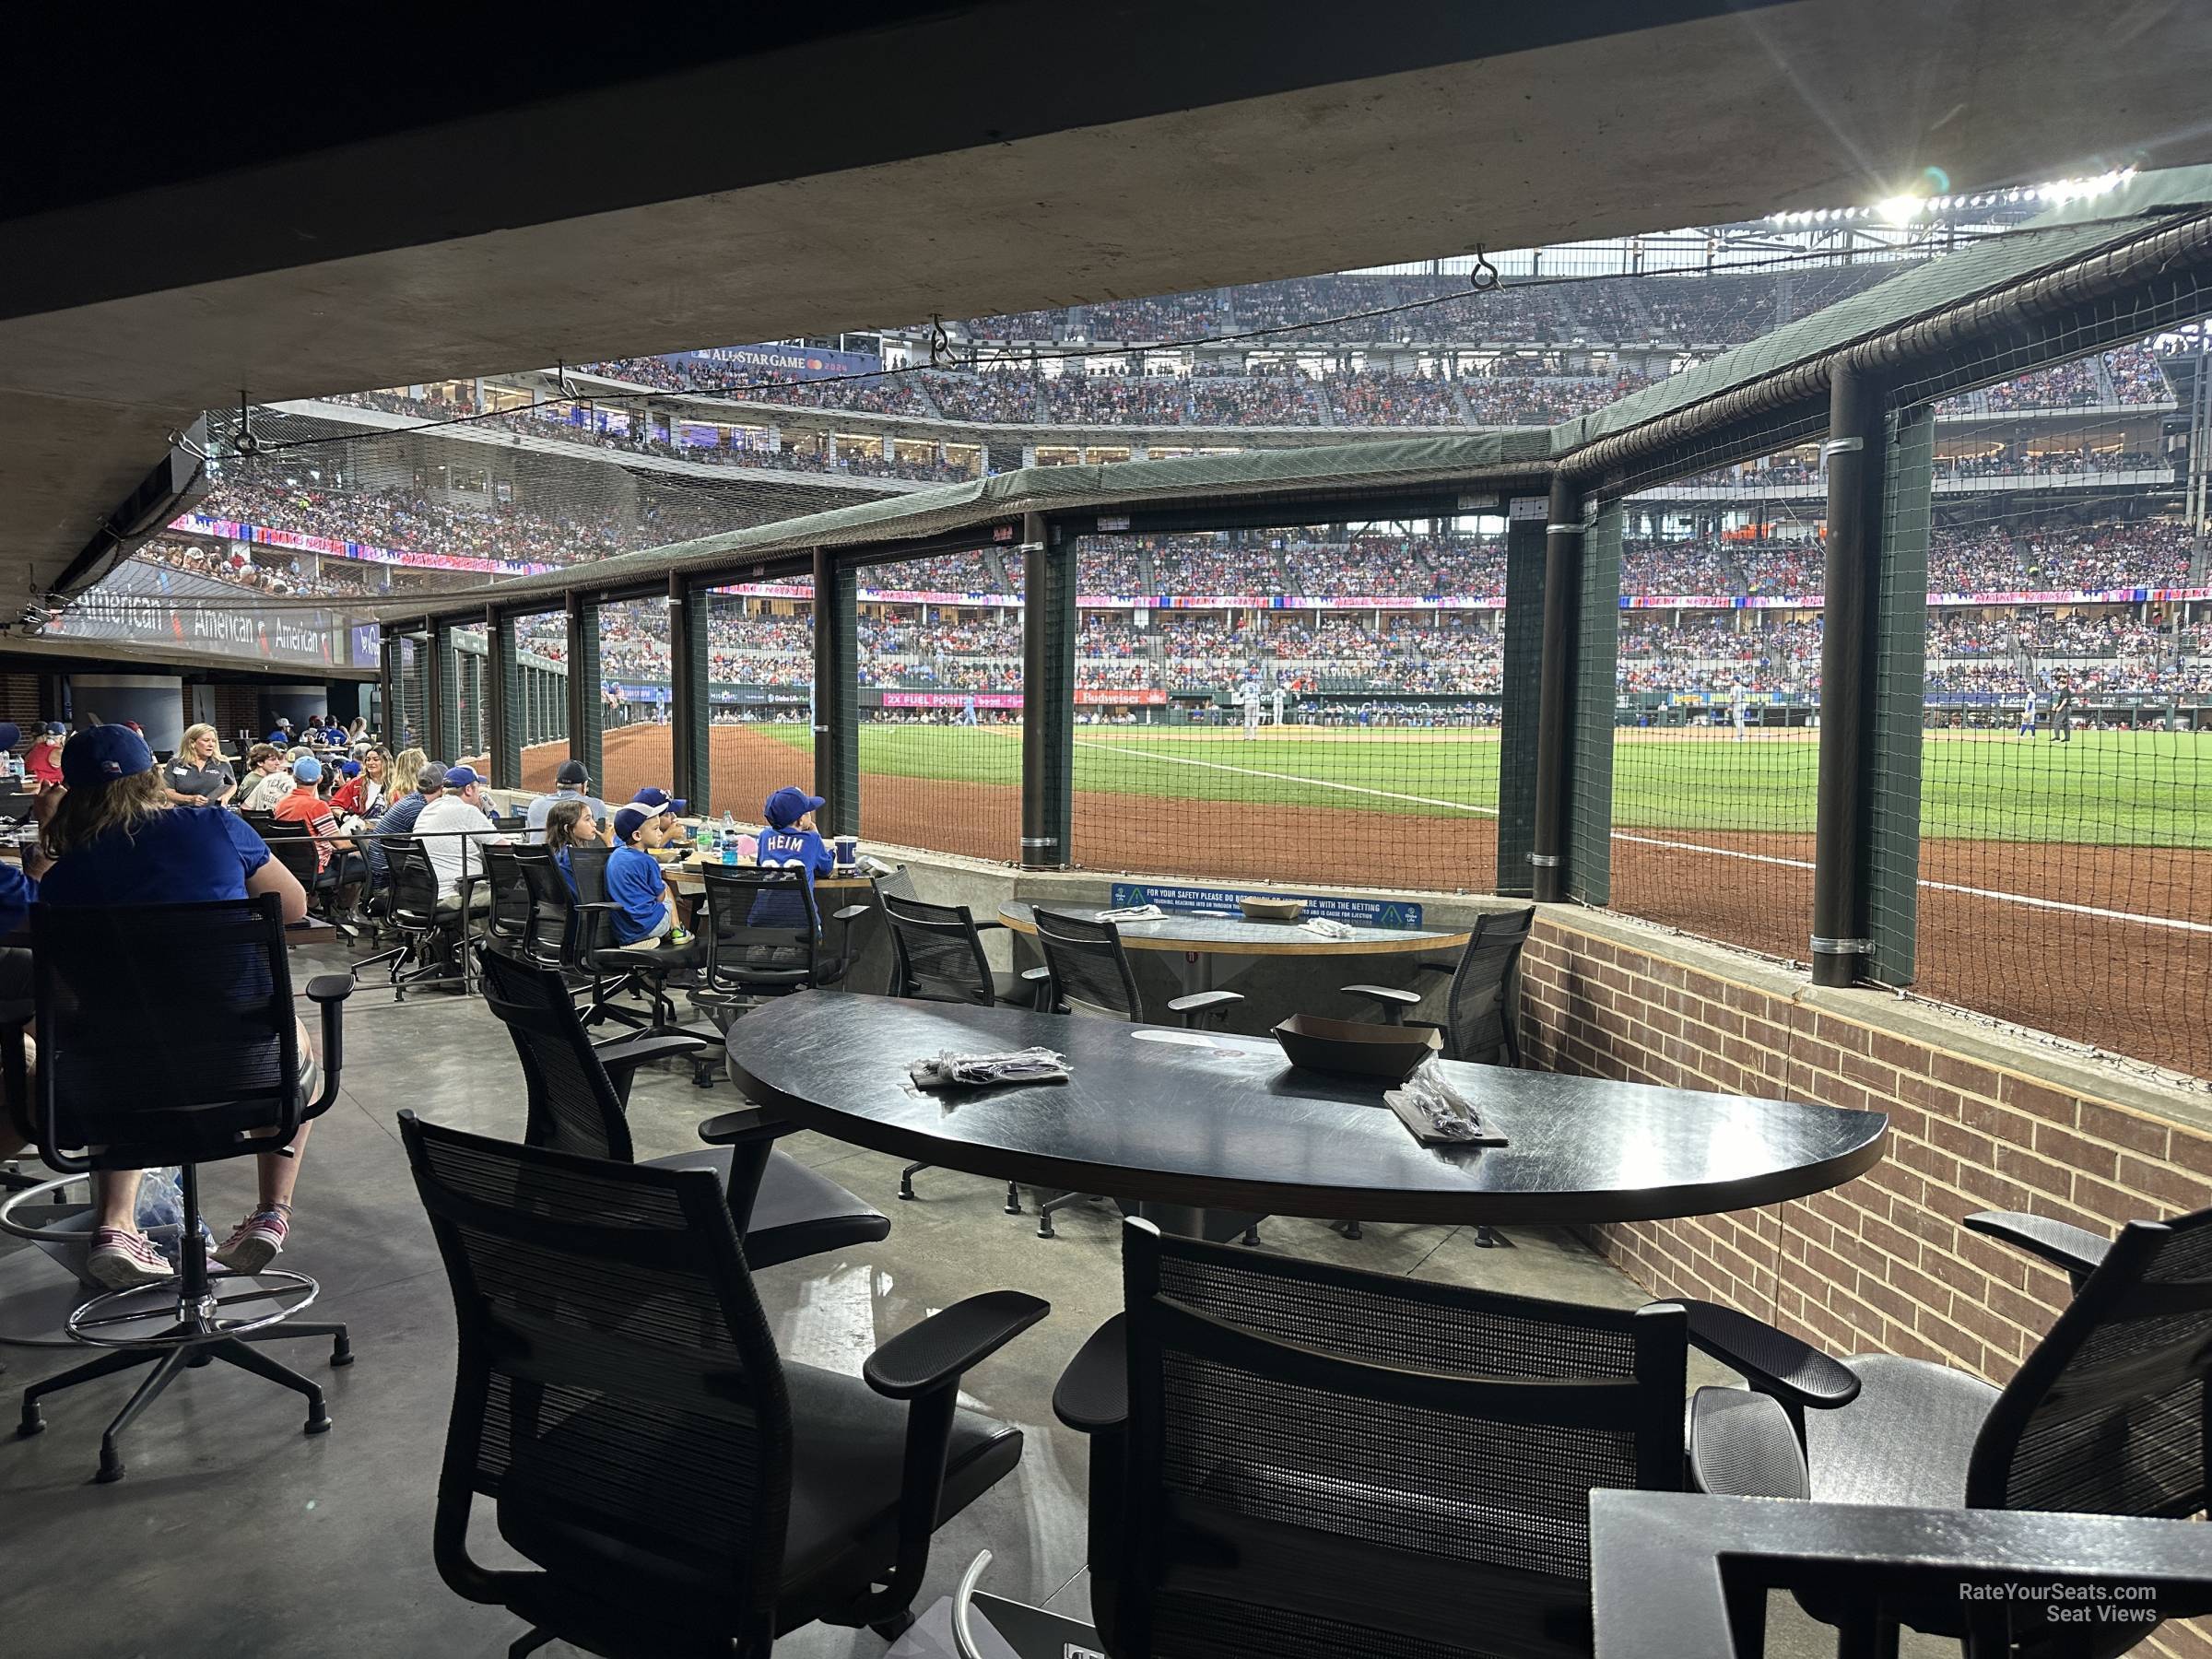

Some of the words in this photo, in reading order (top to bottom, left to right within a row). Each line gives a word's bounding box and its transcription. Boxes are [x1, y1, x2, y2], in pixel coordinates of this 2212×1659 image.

[769, 354, 806, 369] GAME
[824, 363, 847, 371] 2024
[1975, 592, 2020, 604] MAKE
[2025, 591, 2073, 603] NOISE
[77, 582, 162, 631] American
[194, 601, 253, 643] American
[276, 617, 318, 653] American
[888, 696, 900, 704] 2X
[904, 696, 930, 705] FUEL
[1083, 692, 1140, 702] Budweiser
[266, 779, 288, 794] TEXAS
[768, 835, 804, 852] HEIM
[1147, 888, 1159, 897] FOR
[1177, 891, 1199, 900] SAFETY
[1200, 892, 1223, 901] PLEASE
[1224, 894, 1234, 902] DO
[1318, 900, 1335, 910] WITH
[1337, 901, 1350, 911] THE
[1351, 902, 1381, 912] NETTING
